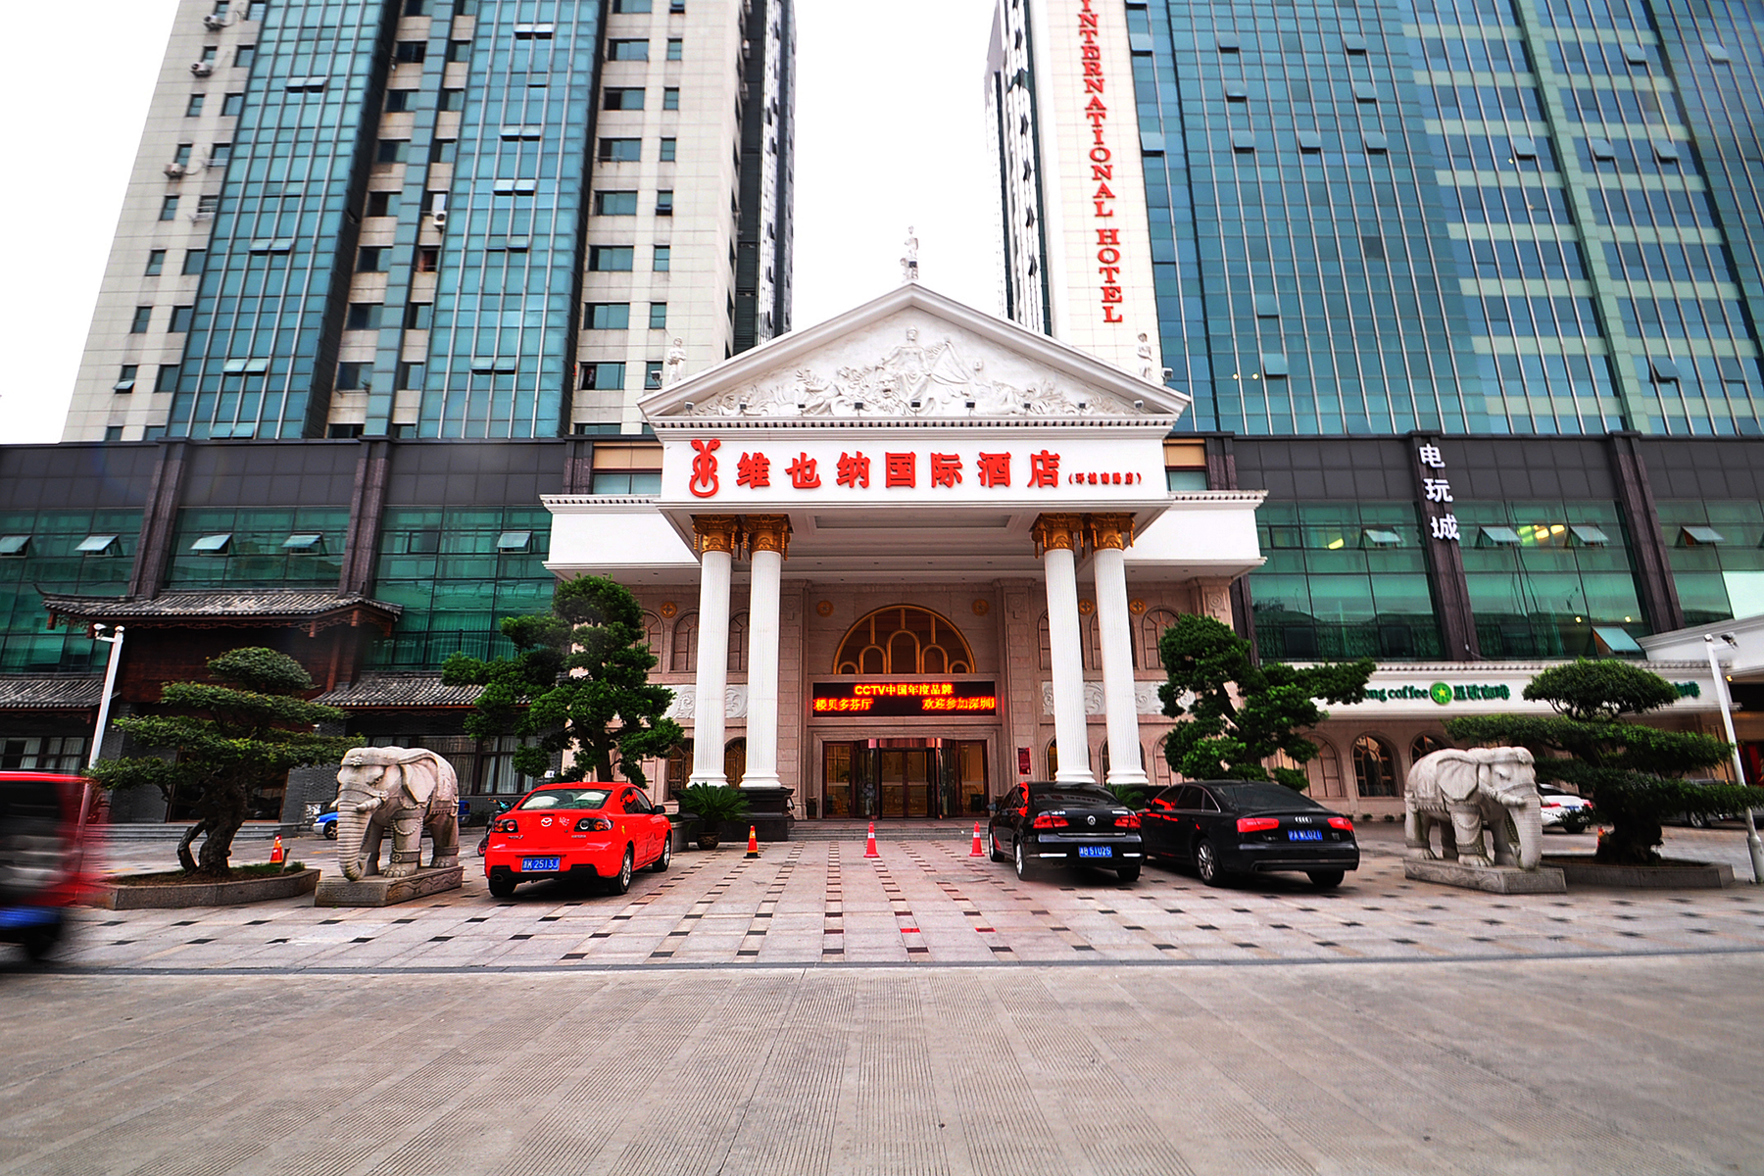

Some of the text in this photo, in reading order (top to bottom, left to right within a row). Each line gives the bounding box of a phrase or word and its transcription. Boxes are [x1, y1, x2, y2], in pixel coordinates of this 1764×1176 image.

[1077, 0, 1123, 323] INTERNATIONAL HOTEL
[736, 450, 1061, 489] 维也纳国际酒店
[1418, 442, 1461, 541] 电玩城
[813, 697, 874, 711] 楼贝多芬厅
[1387, 684, 1429, 700] coffee
